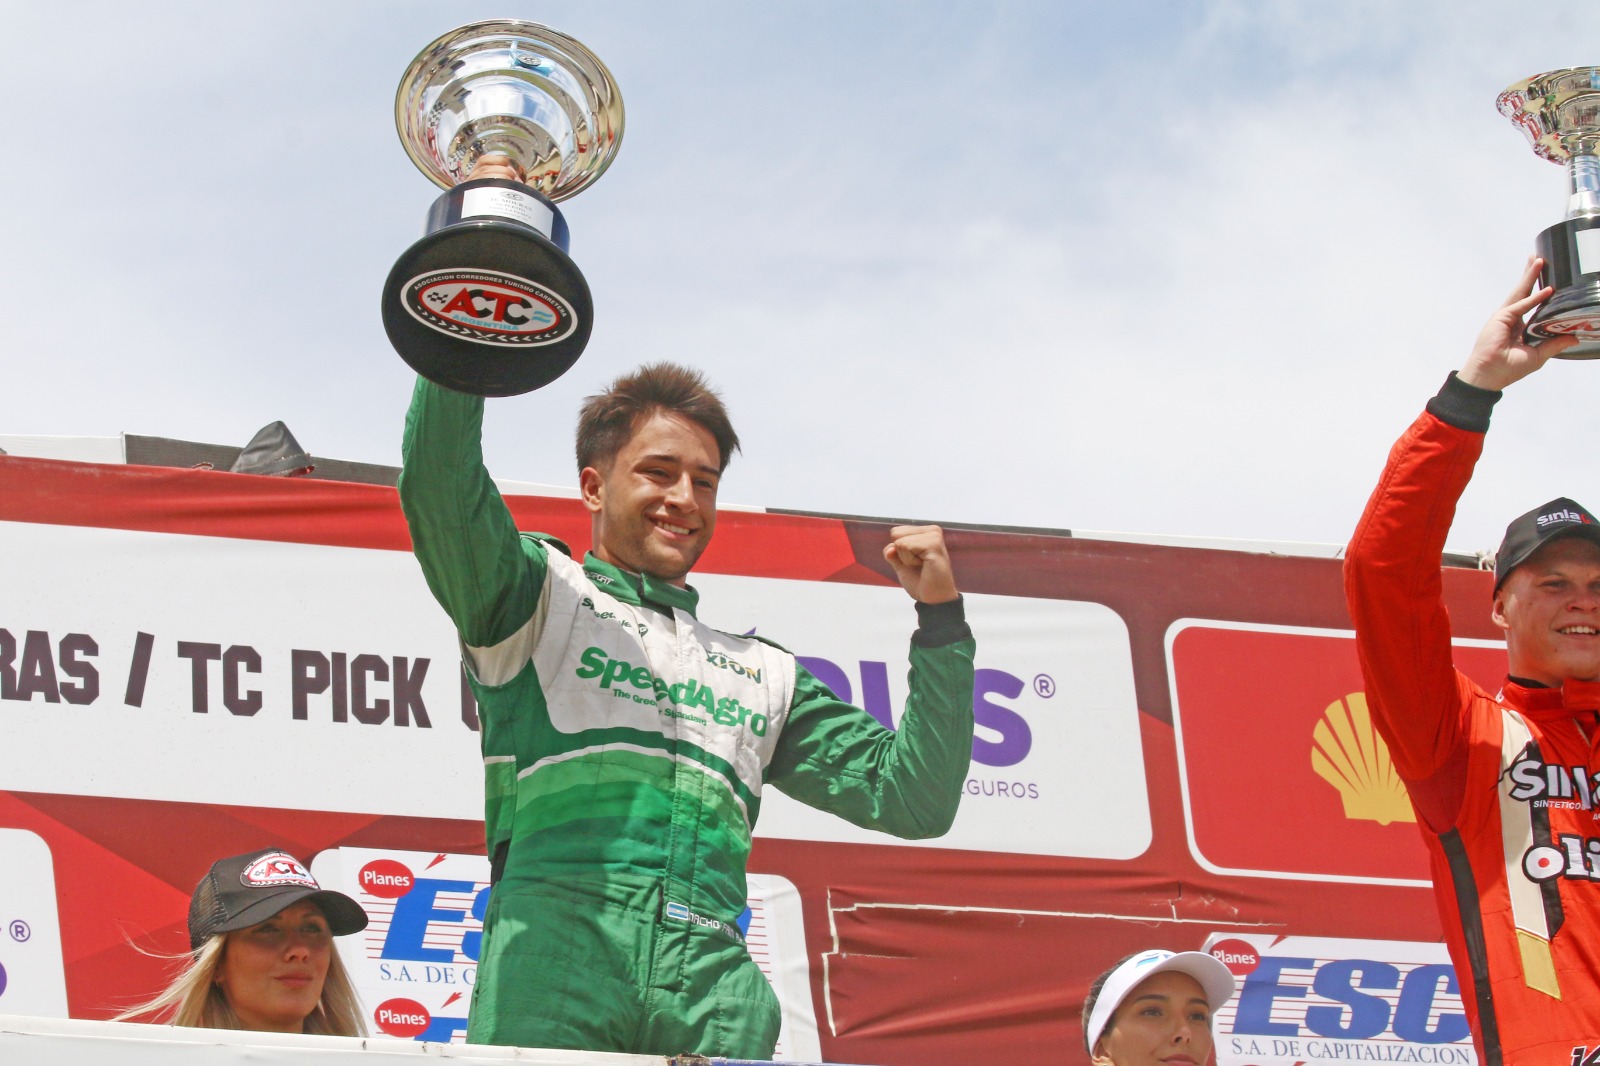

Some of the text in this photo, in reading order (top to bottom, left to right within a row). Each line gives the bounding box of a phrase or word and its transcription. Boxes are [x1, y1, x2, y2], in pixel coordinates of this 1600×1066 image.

[414, 274, 568, 318] ASOCIACION CORREDORES TURISMO CARRETERA
[440, 287, 533, 326] ACTC
[452, 314, 520, 331] ARGENTINA
[706, 655, 761, 684] XION
[177, 641, 262, 717] TC
[291, 649, 432, 729] PICK
[576, 646, 768, 738] SpeedAgro
[613, 688, 631, 699] The
[961, 778, 1039, 799] GUROS
[363, 870, 410, 888] Planes
[1213, 950, 1257, 965] Planes
[380, 963, 417, 982] S.A.
[425, 966, 456, 985] DE
[379, 1010, 426, 1026] Planes
[1231, 1038, 1471, 1065] S.A. DE CAPITALIZACION
